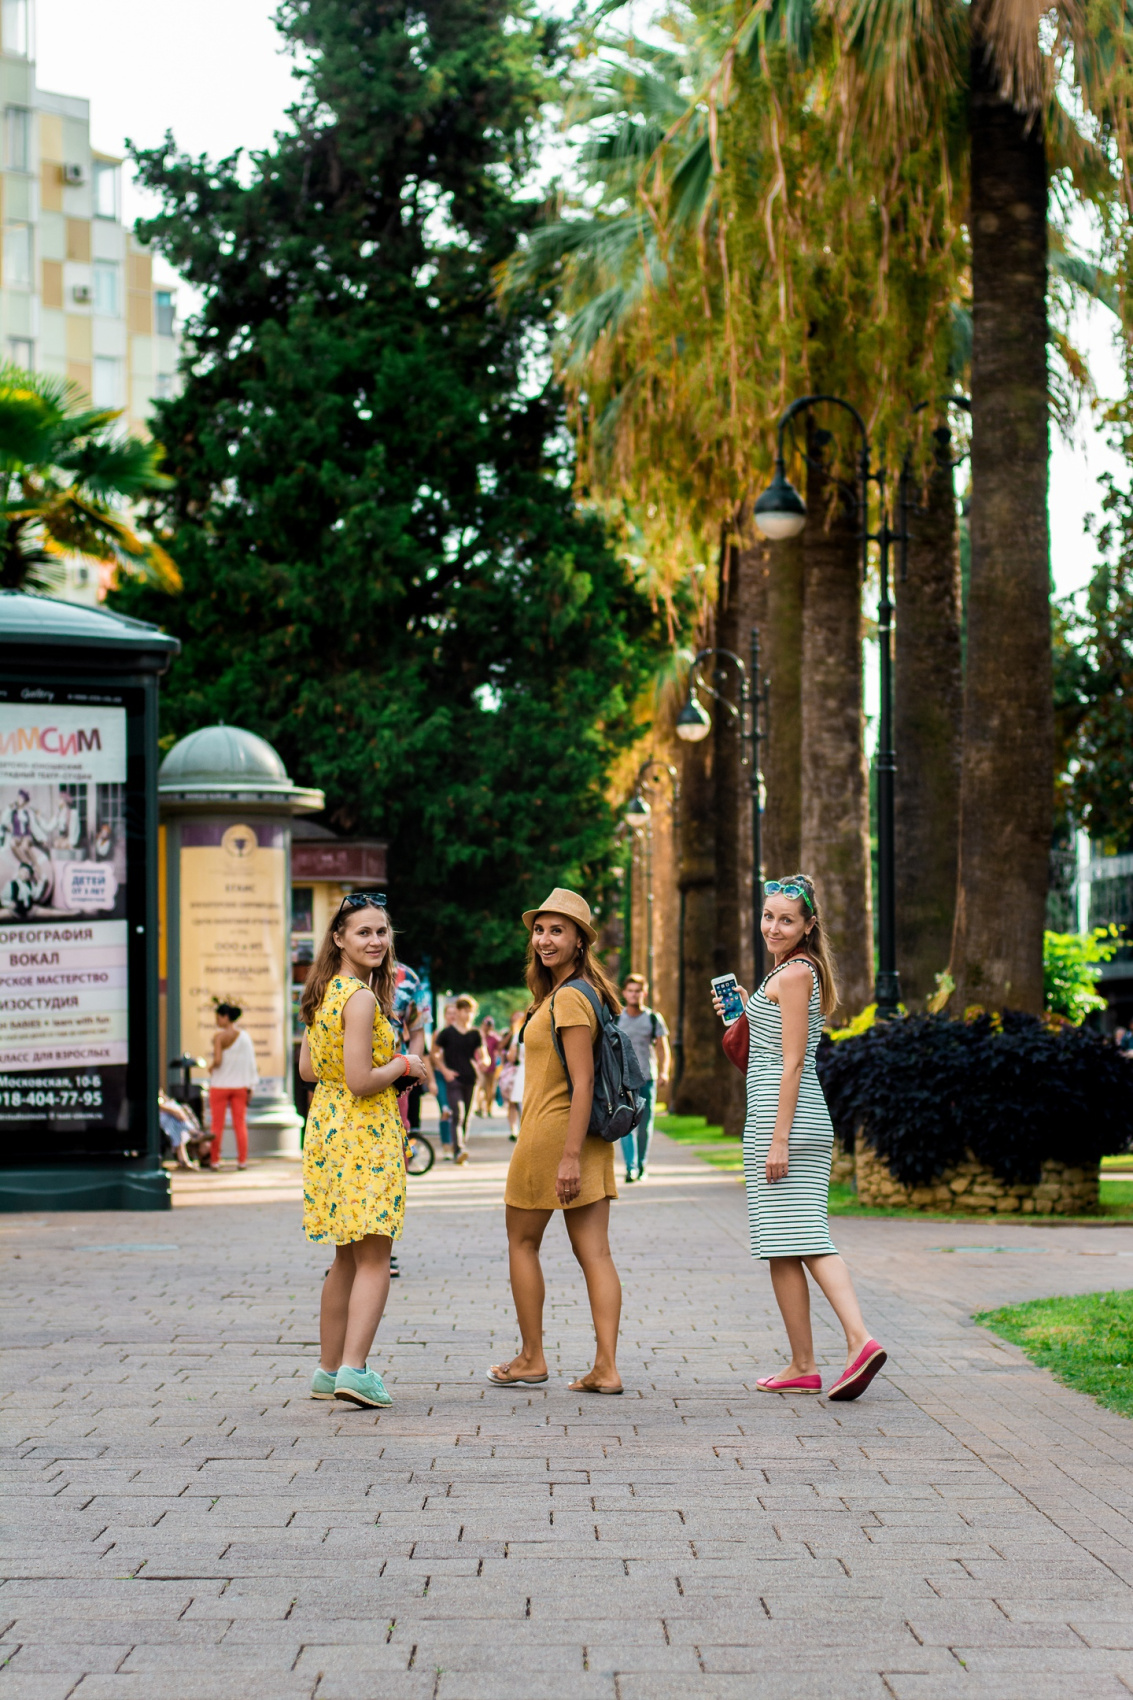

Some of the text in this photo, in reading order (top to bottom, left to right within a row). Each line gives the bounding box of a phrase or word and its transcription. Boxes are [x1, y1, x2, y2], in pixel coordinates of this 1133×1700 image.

[21, 687, 54, 702] Gallery
[72, 876, 106, 886] ДЕТЕЙ
[0, 928, 93, 944] ОРЕОГРАФИЯ
[9, 952, 60, 967] ВОКАЛ
[36, 972, 109, 985] МАСТЕРСТВО
[0, 996, 79, 1012] ИЗОСТУДИЯ
[33, 1051, 53, 1062] ДЛЯ
[55, 1049, 110, 1060] ВЗРОСЛЫХ
